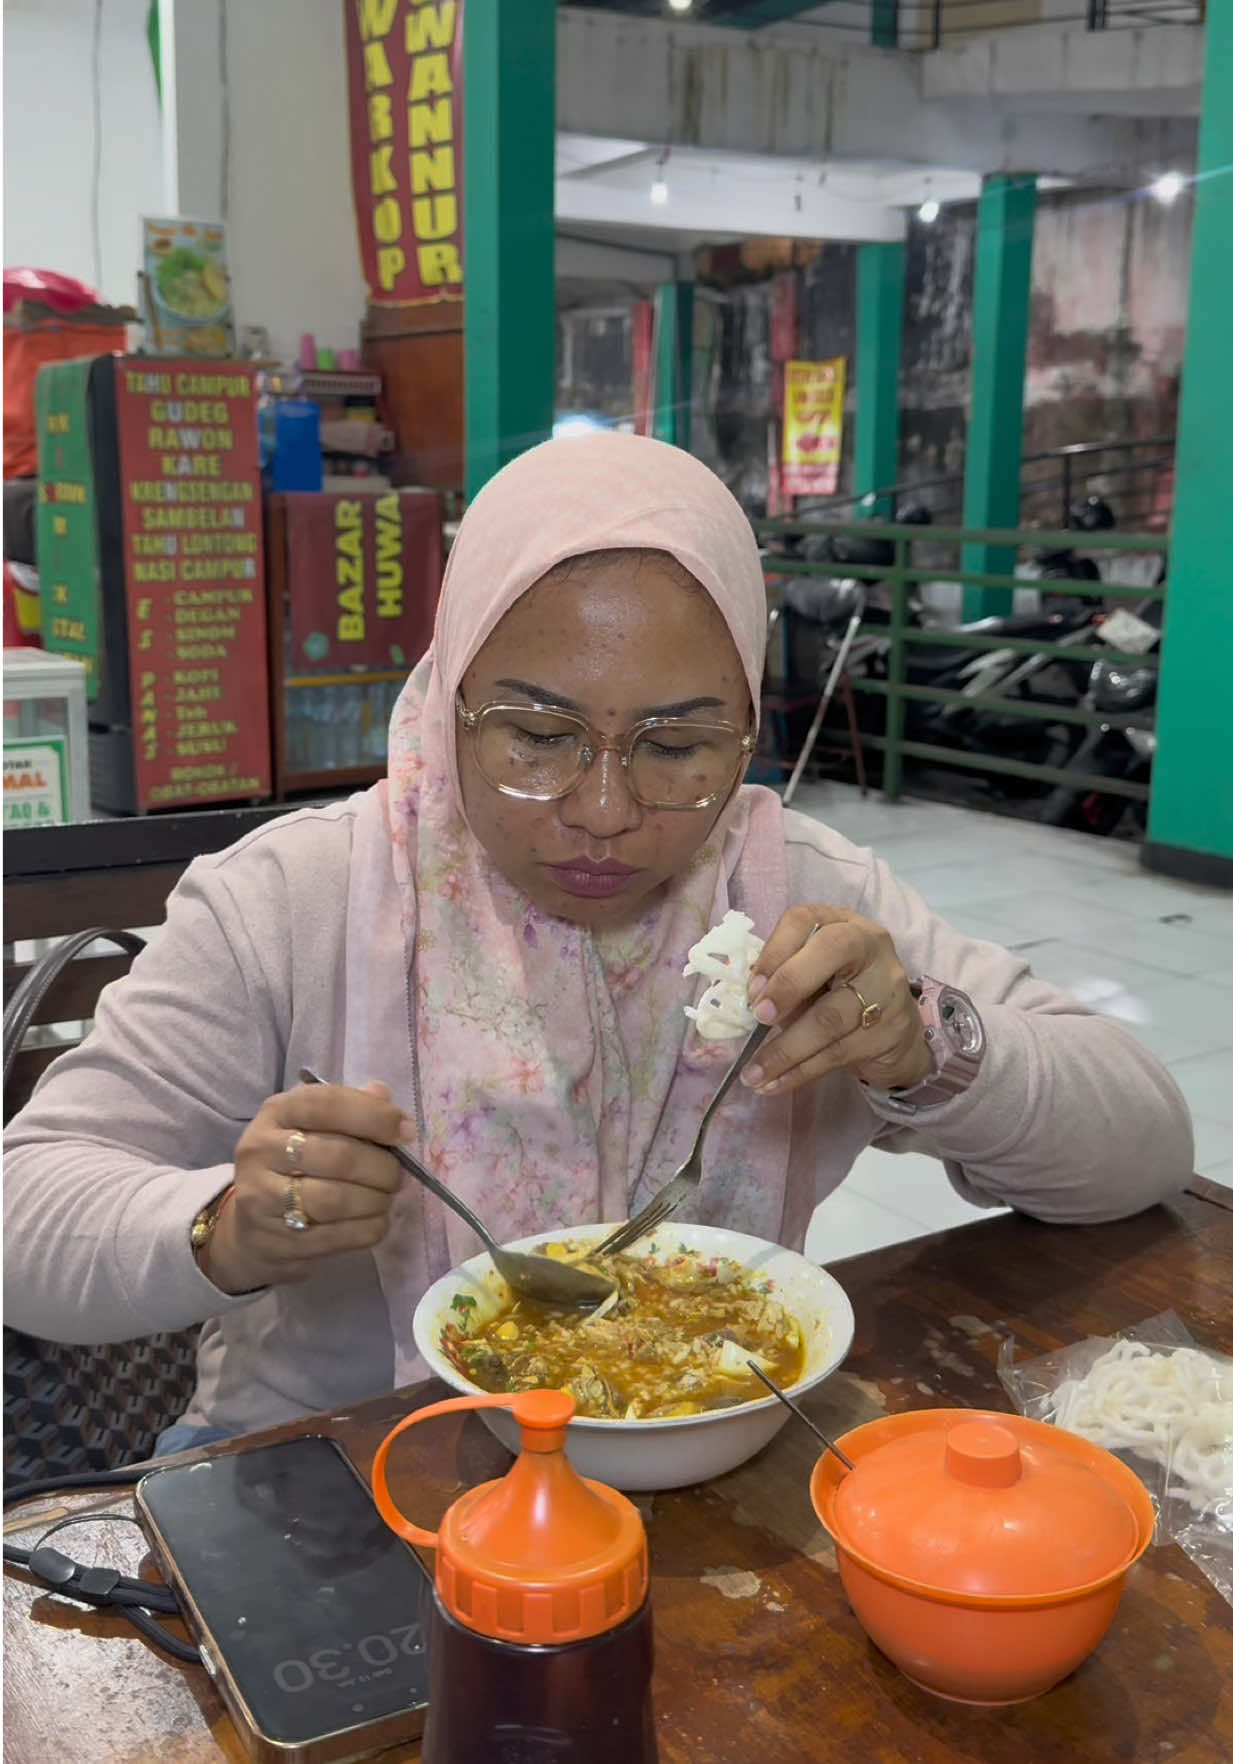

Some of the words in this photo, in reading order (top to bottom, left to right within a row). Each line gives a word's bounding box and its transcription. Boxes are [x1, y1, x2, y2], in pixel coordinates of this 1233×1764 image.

[359, 0, 406, 291] WARKOP
[405, 0, 463, 286] WANNUR
[126, 370, 171, 395] TAHU
[176, 374, 251, 398] CAMPUR
[151, 401, 229, 424] GUDEG
[148, 427, 233, 451] RAWON
[162, 455, 222, 477] KARE
[134, 560, 176, 582] NASI
[181, 558, 257, 581] CAMPUR
[335, 500, 365, 641] BAZAR
[375, 489, 403, 618] HUWA
[273, 1623, 426, 1693] 20.30
